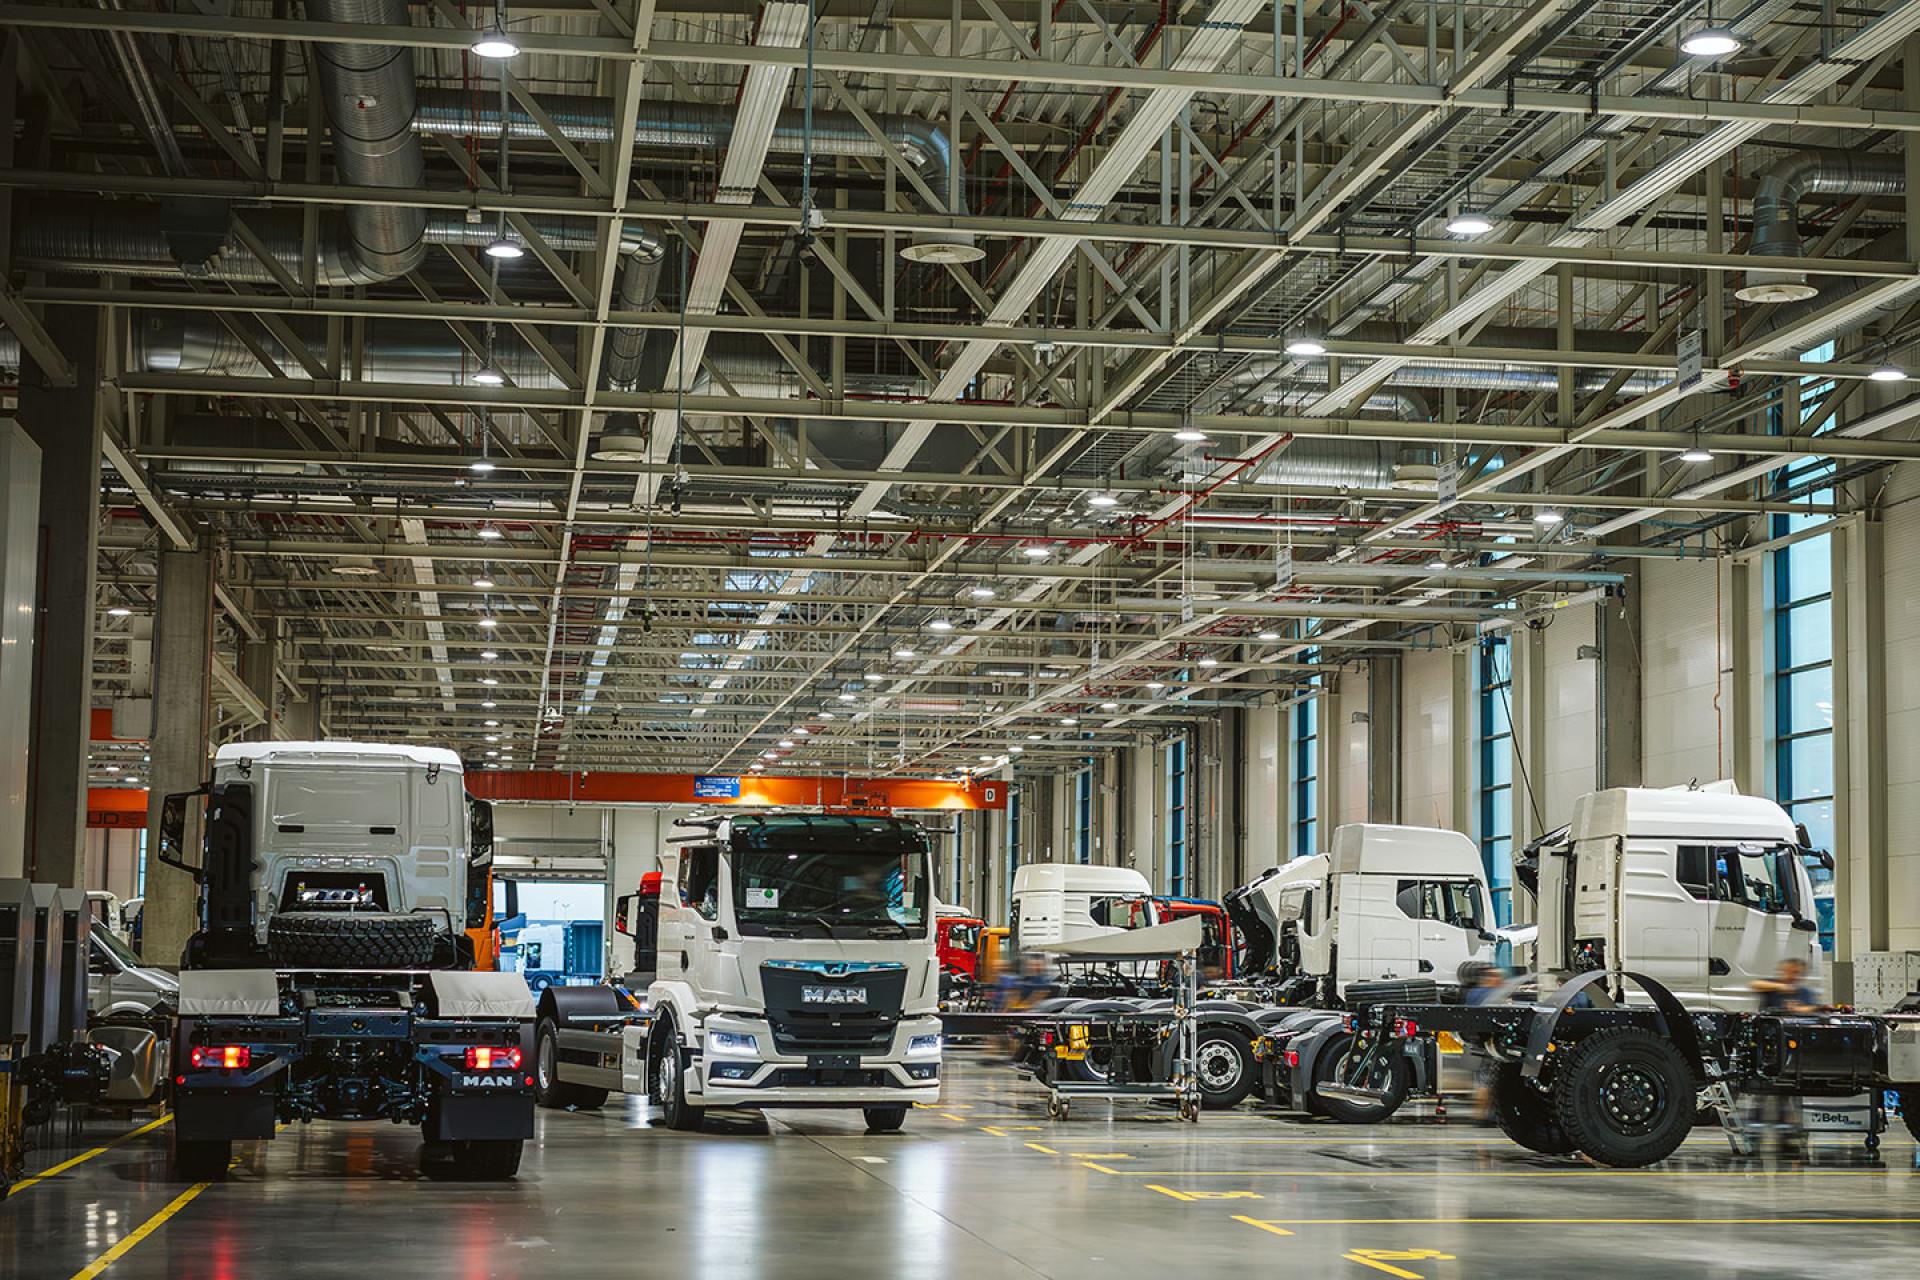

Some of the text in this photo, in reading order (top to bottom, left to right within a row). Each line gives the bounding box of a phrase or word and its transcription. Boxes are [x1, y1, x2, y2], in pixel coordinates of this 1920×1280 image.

[987, 790, 994, 801] D
[803, 986, 868, 1004] MAN
[463, 1075, 513, 1087] MAN
[1823, 1112, 1849, 1122] Beta
